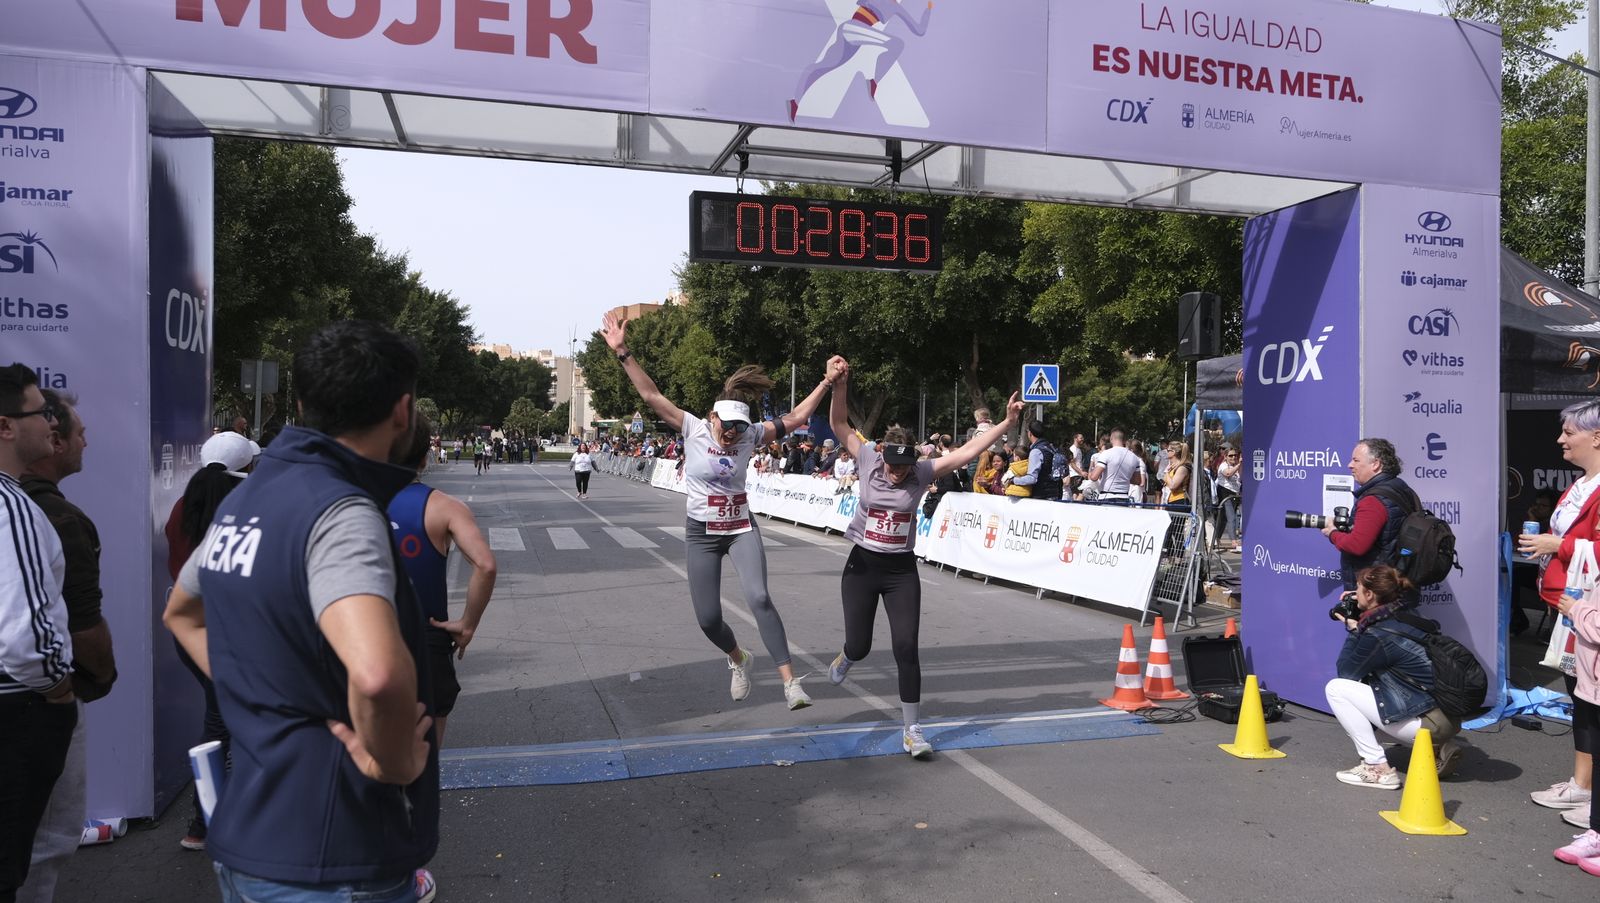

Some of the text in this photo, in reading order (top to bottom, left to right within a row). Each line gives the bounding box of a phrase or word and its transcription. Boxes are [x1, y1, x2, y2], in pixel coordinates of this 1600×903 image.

[175, 0, 599, 65] JER
[1141, 3, 1322, 54] LA IGUALDAD
[1092, 43, 1364, 104] ES NUESTRA META.
[1106, 97, 1154, 124] CDX
[1204, 107, 1255, 124] ALMERÍA
[1203, 121, 1231, 131] CIUDAD
[736, 201, 931, 263] 00:28:36
[1405, 234, 1464, 248] HYUNDAI
[1412, 247, 1458, 260] Almerialva
[1420, 274, 1468, 289] cajamar
[26, 323, 69, 333] cuidarte
[165, 288, 207, 354] CDX
[1408, 315, 1450, 337] CASI
[1258, 325, 1334, 386] CDX
[1421, 352, 1465, 367] vithas
[1412, 399, 1463, 418] aqualia
[1275, 447, 1342, 468] ALMERÍA
[1275, 469, 1306, 480] CIUDAD
[1414, 466, 1448, 479] Clece
[718, 505, 741, 518] 516
[876, 520, 900, 532] 517
[1007, 520, 1060, 543] ALMERÍA
[1004, 540, 1031, 553] CIUDAD
[1088, 530, 1155, 555] ALMERÍA
[1086, 552, 1118, 567] CIUDAD
